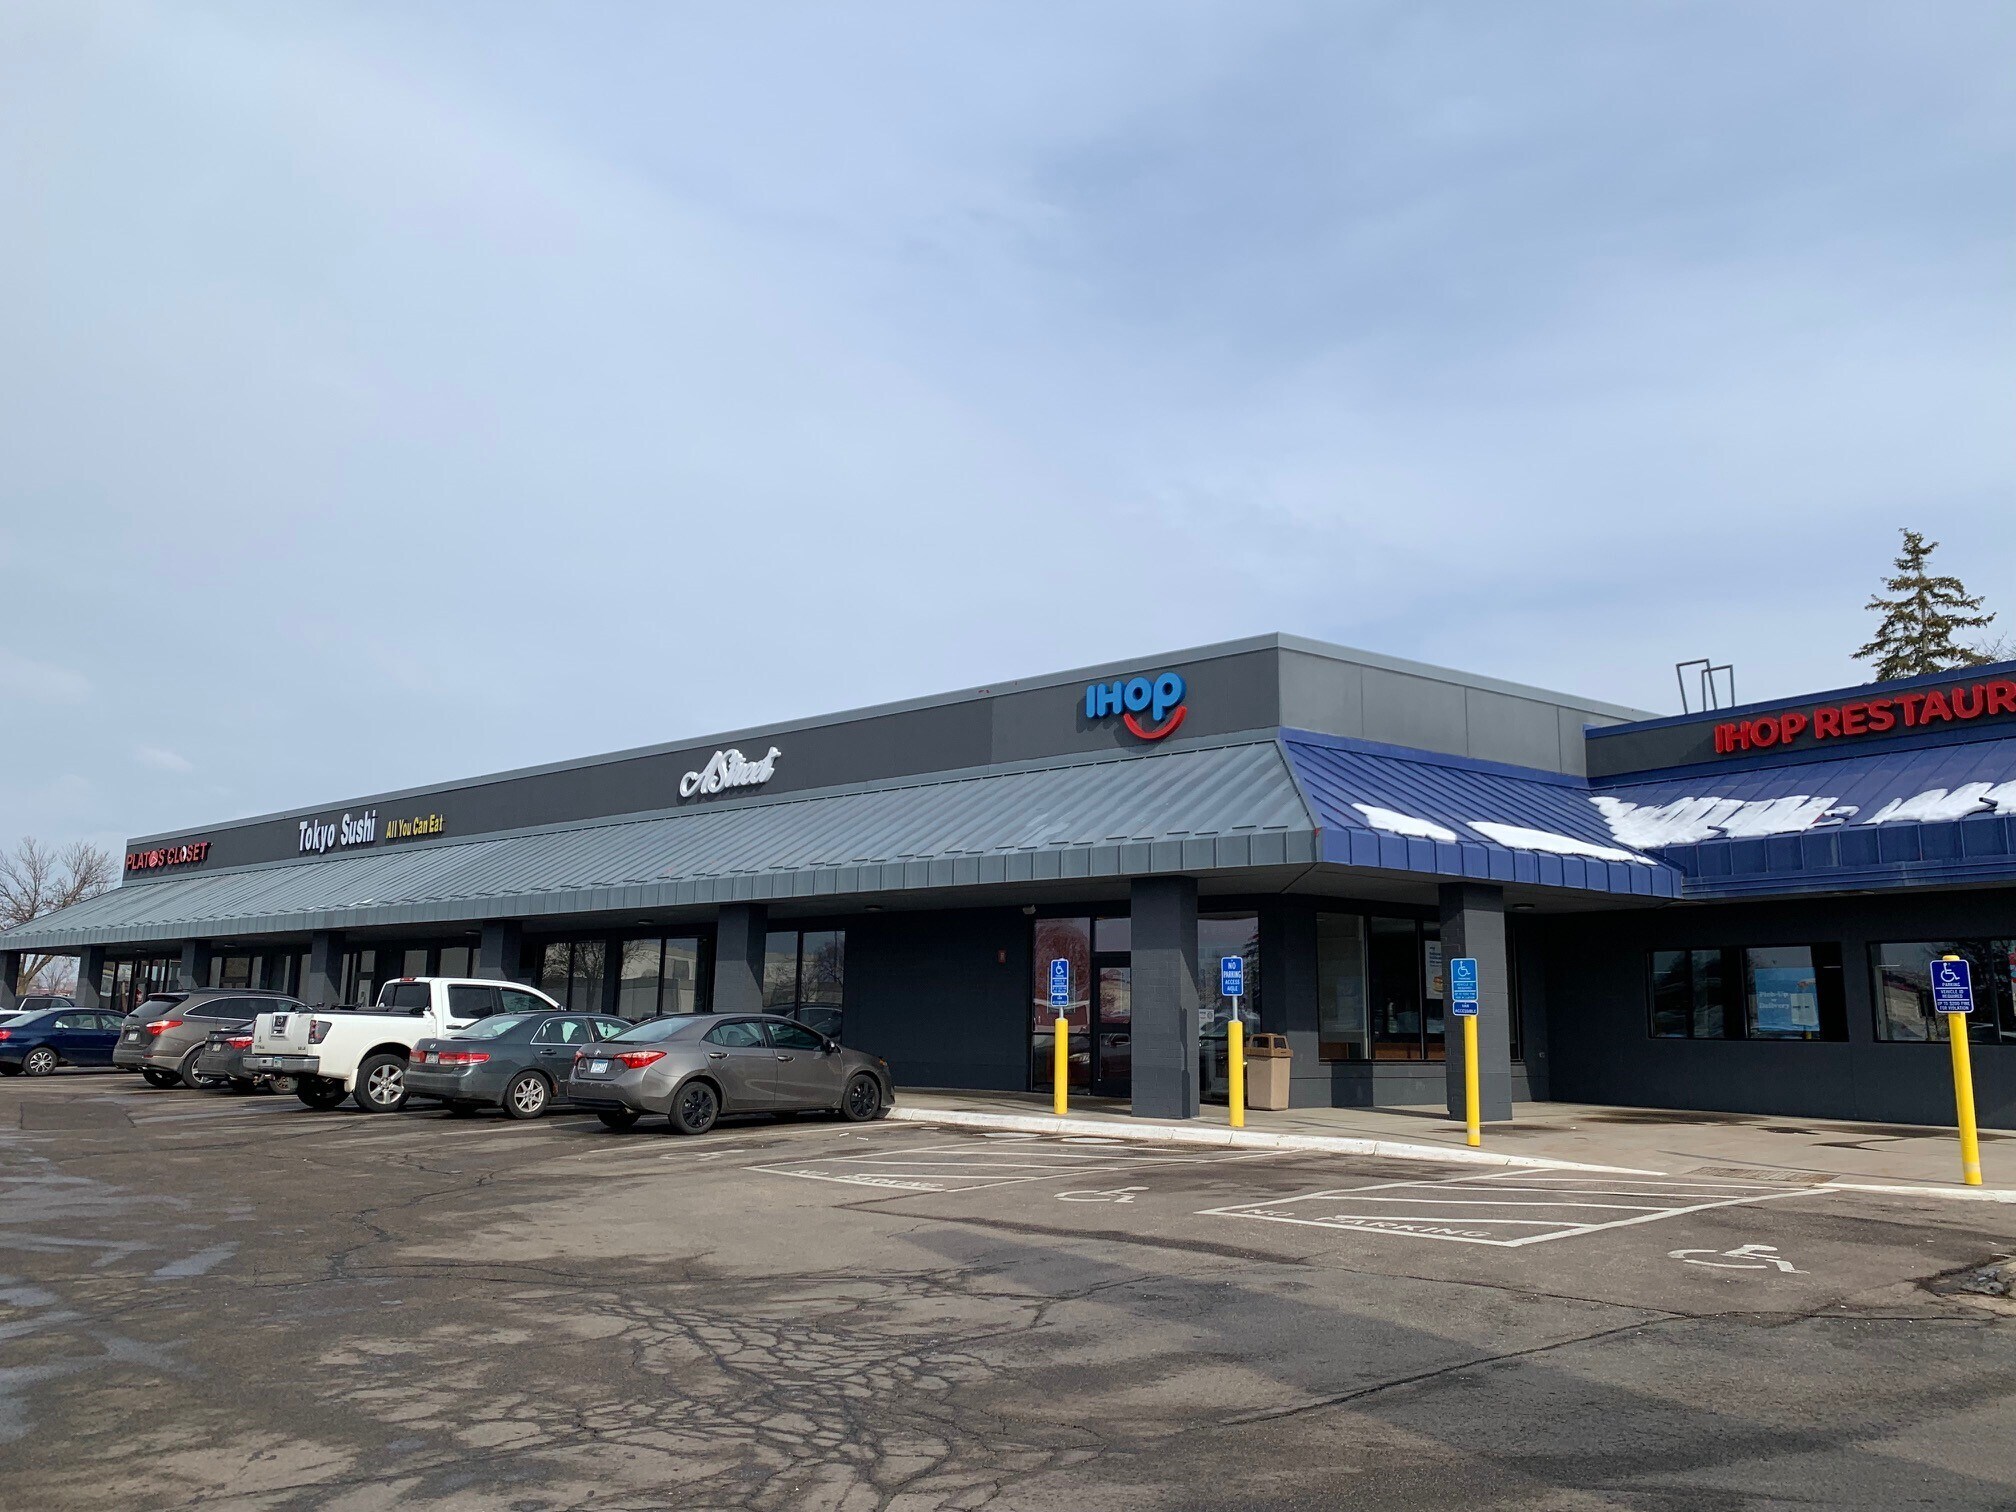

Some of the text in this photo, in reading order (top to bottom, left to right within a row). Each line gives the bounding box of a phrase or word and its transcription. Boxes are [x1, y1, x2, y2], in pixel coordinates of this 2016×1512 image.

[1086, 672, 1186, 722] IHOP
[1714, 680, 2016, 754] IHOP RESTAUR
[299, 810, 376, 853] Tokyo Sushi
[386, 814, 443, 839] All You Can Eat
[167, 842, 208, 865] CLOSET
[1223, 970, 1242, 978] PARKING
[1227, 962, 1236, 970] NO
